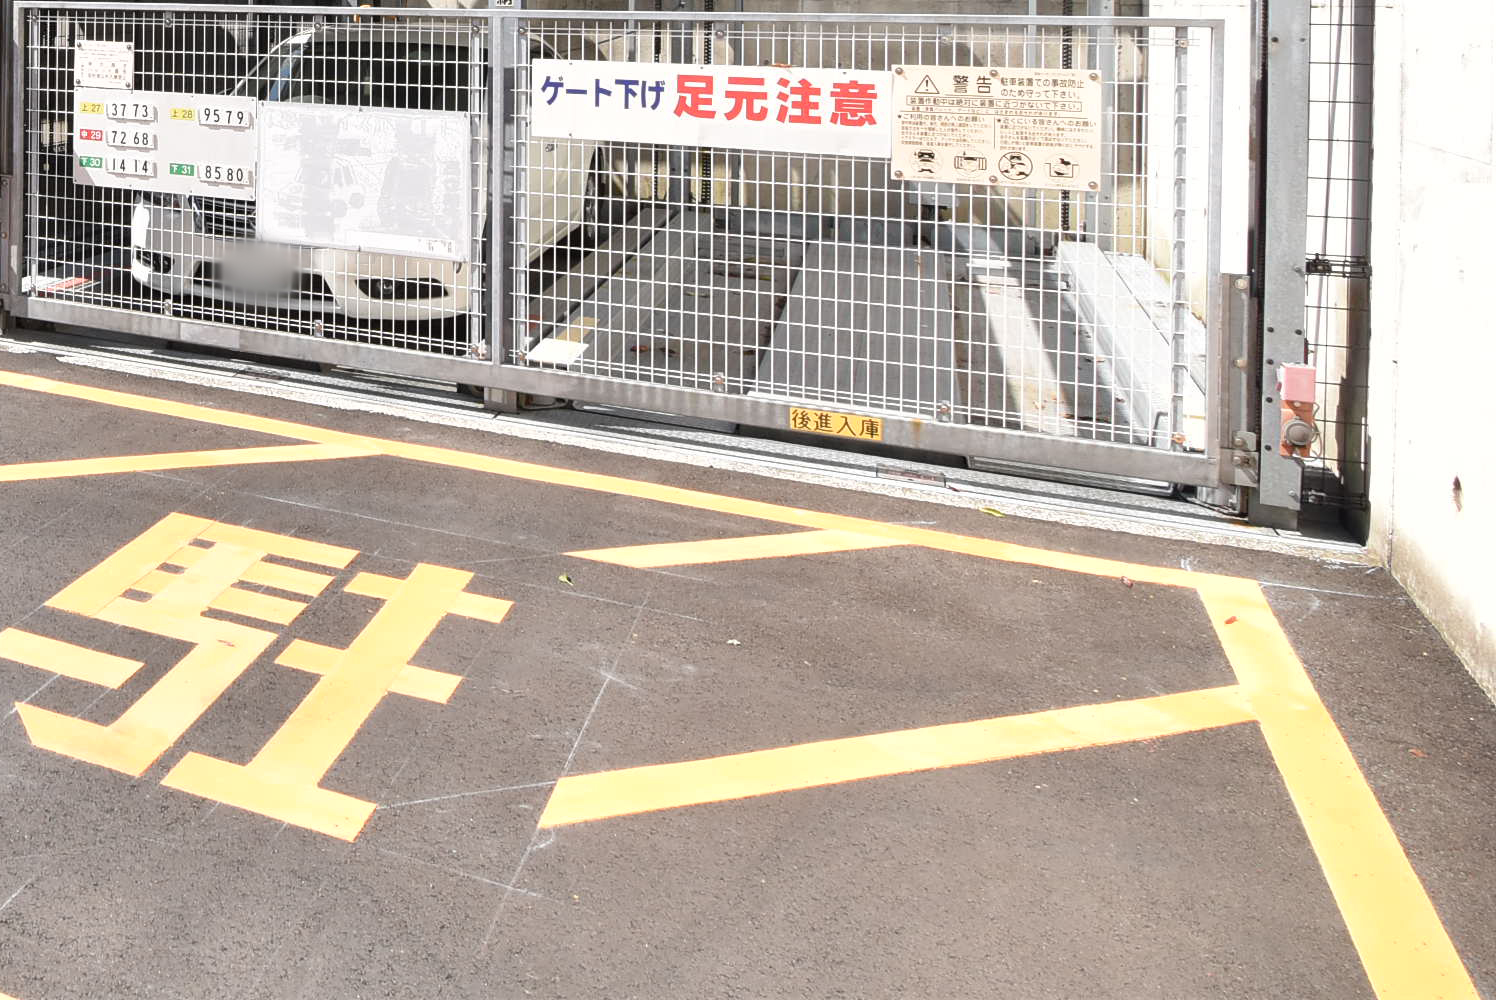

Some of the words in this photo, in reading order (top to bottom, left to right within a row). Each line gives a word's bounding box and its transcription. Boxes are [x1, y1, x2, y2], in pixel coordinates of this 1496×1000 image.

[952, 74, 993, 94] 警告
[540, 74, 666, 111] ゲート下げ
[673, 73, 878, 127] 足元注意
[791, 409, 880, 438] 後進入庫
